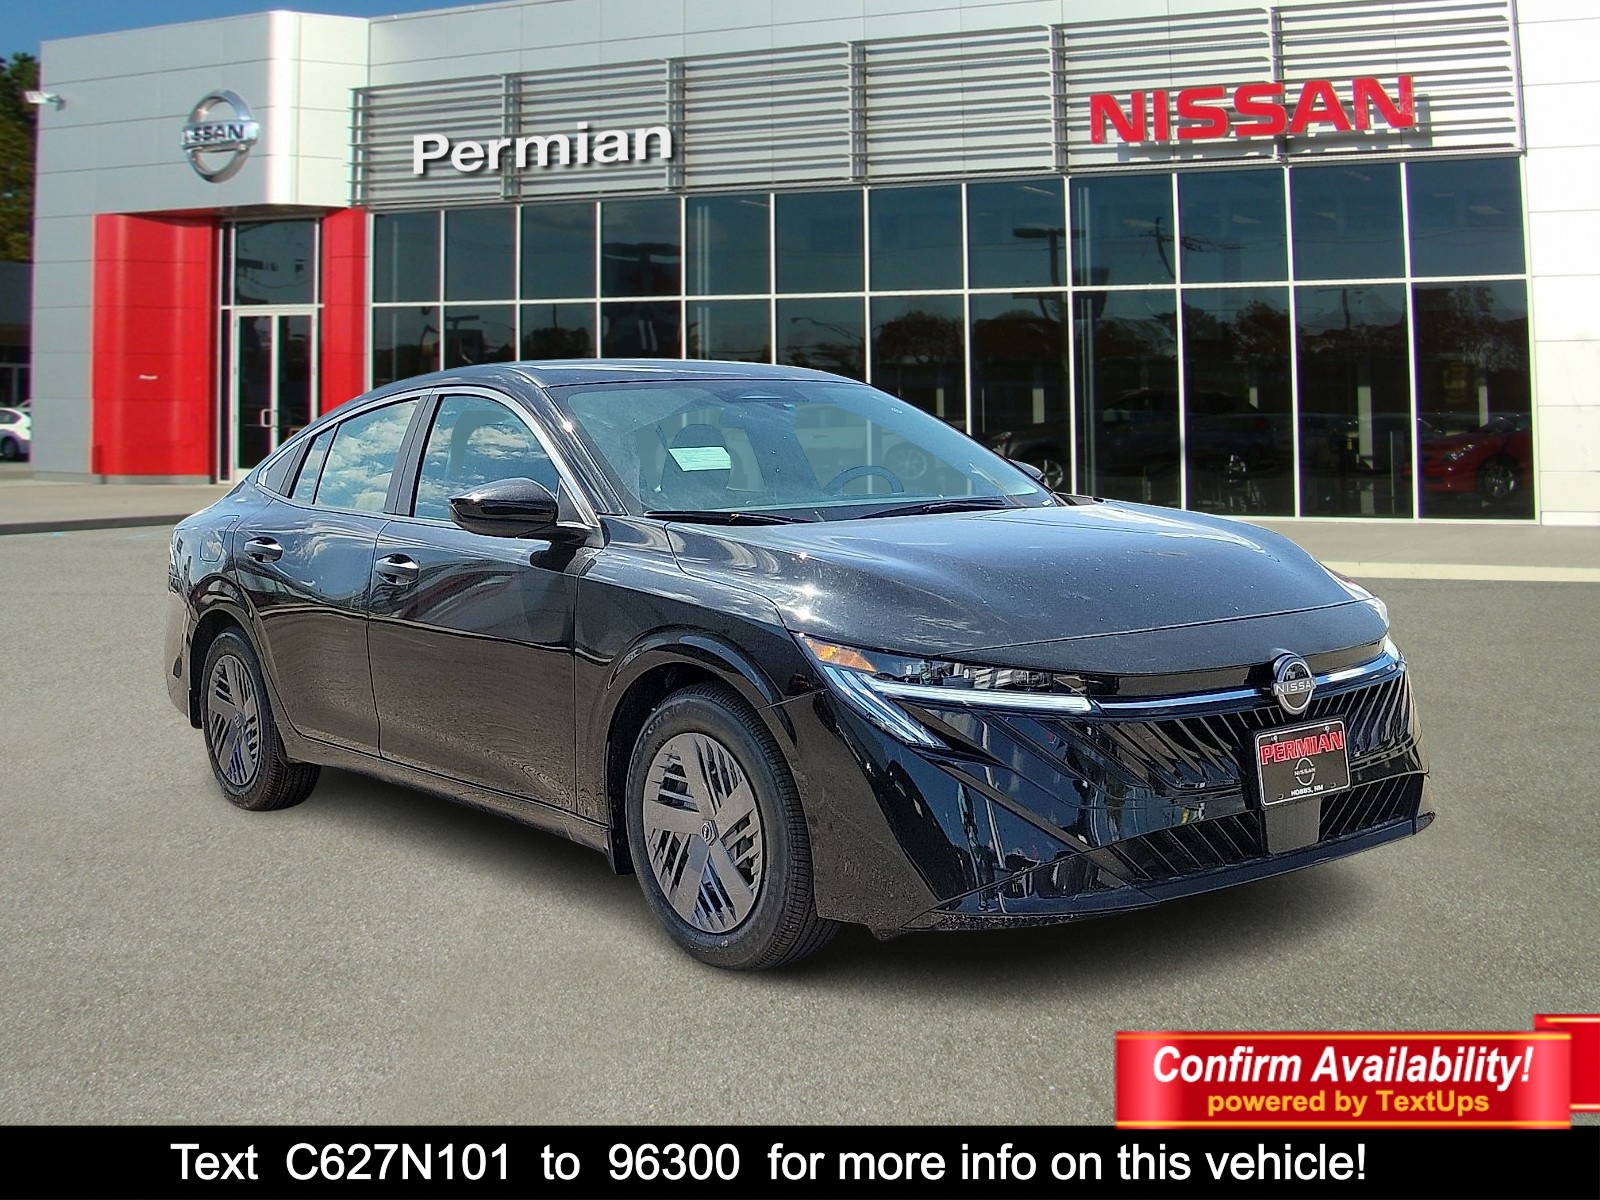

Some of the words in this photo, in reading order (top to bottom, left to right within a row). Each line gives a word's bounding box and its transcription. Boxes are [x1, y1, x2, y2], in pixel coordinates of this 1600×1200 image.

[1089, 75, 1415, 144] NISSAN
[413, 121, 672, 175] Permian
[1276, 678, 1316, 693] NISSAN
[1260, 730, 1344, 765] PERMIAN
[1313, 784, 1324, 793] NM
